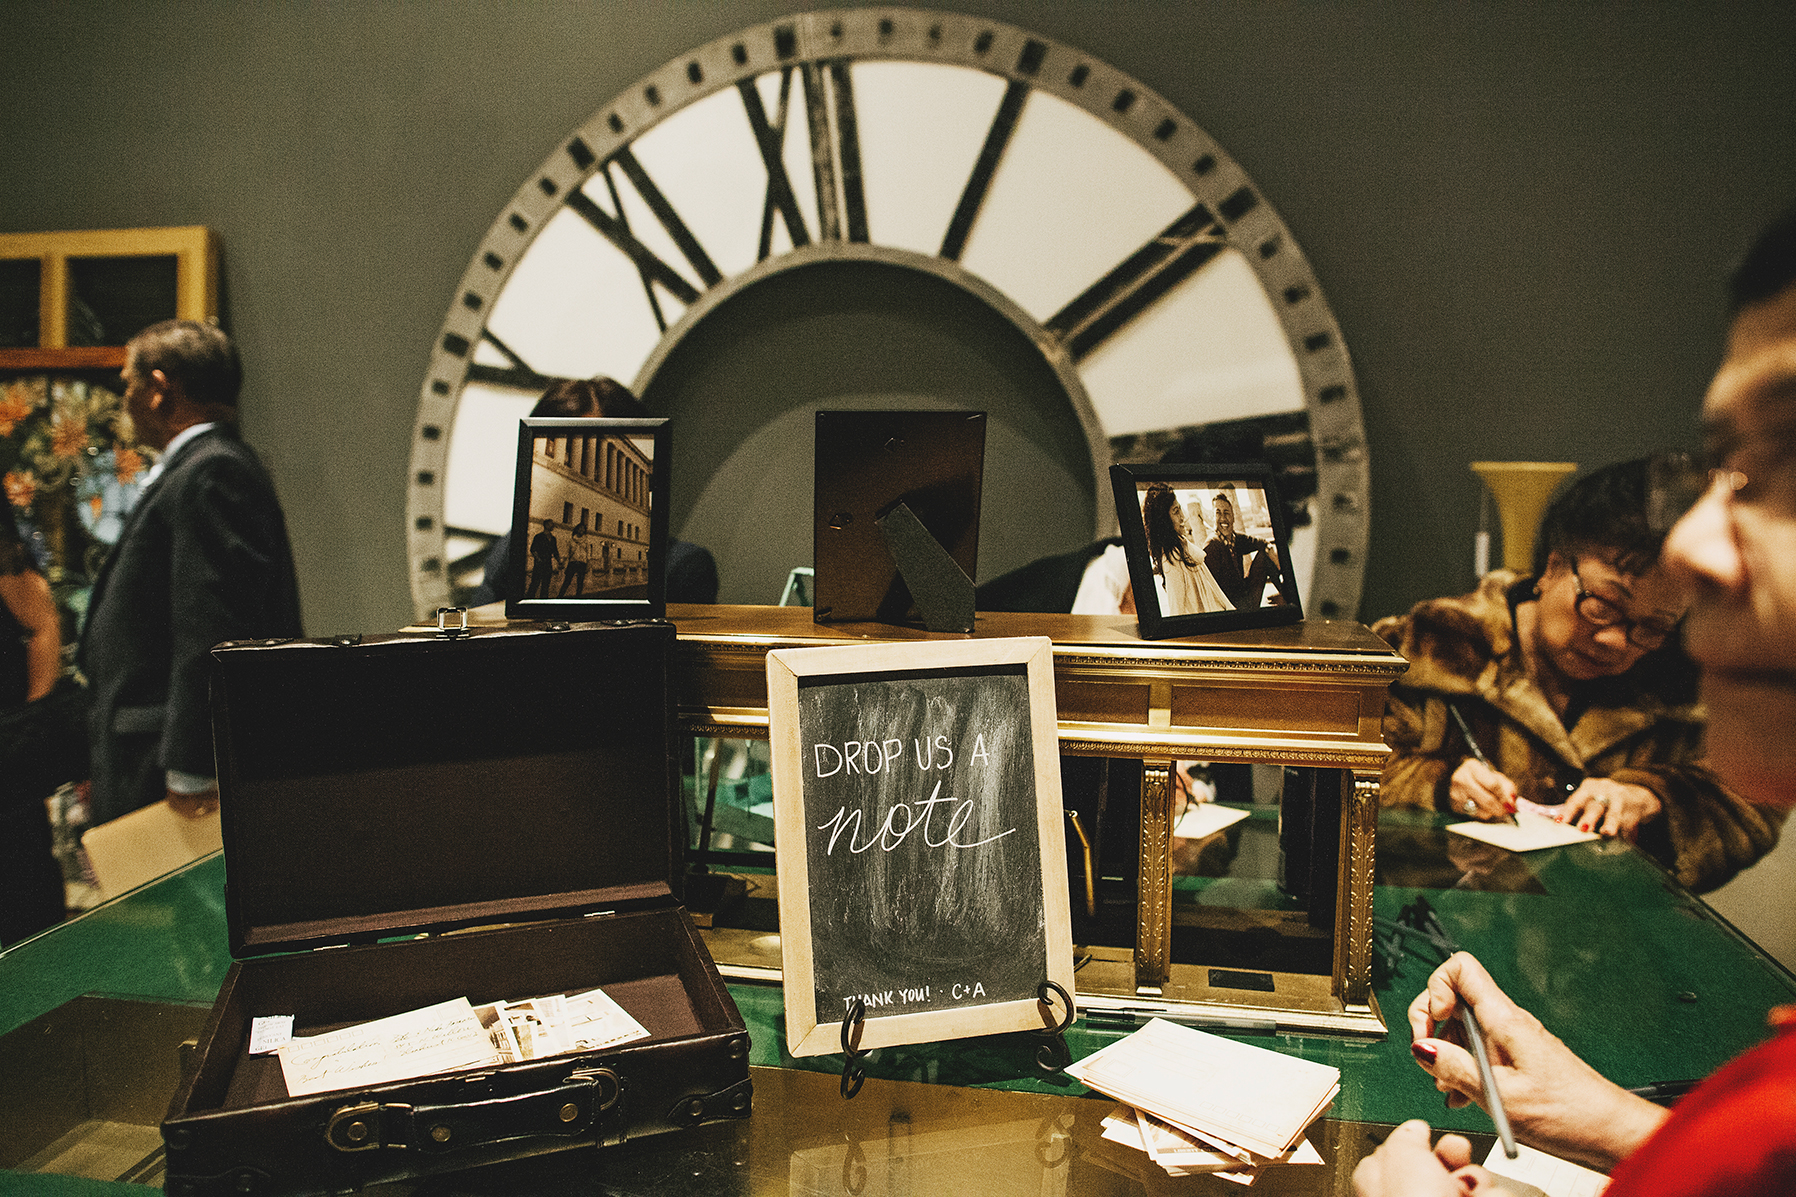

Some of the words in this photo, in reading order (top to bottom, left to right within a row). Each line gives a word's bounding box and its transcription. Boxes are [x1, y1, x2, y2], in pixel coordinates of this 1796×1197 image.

[814, 738, 902, 778] DROP
[914, 736, 953, 771] US
[970, 733, 989, 766] A
[817, 780, 1016, 856] note
[898, 985, 931, 1005] YOU!
[952, 982, 986, 1000] C+A
